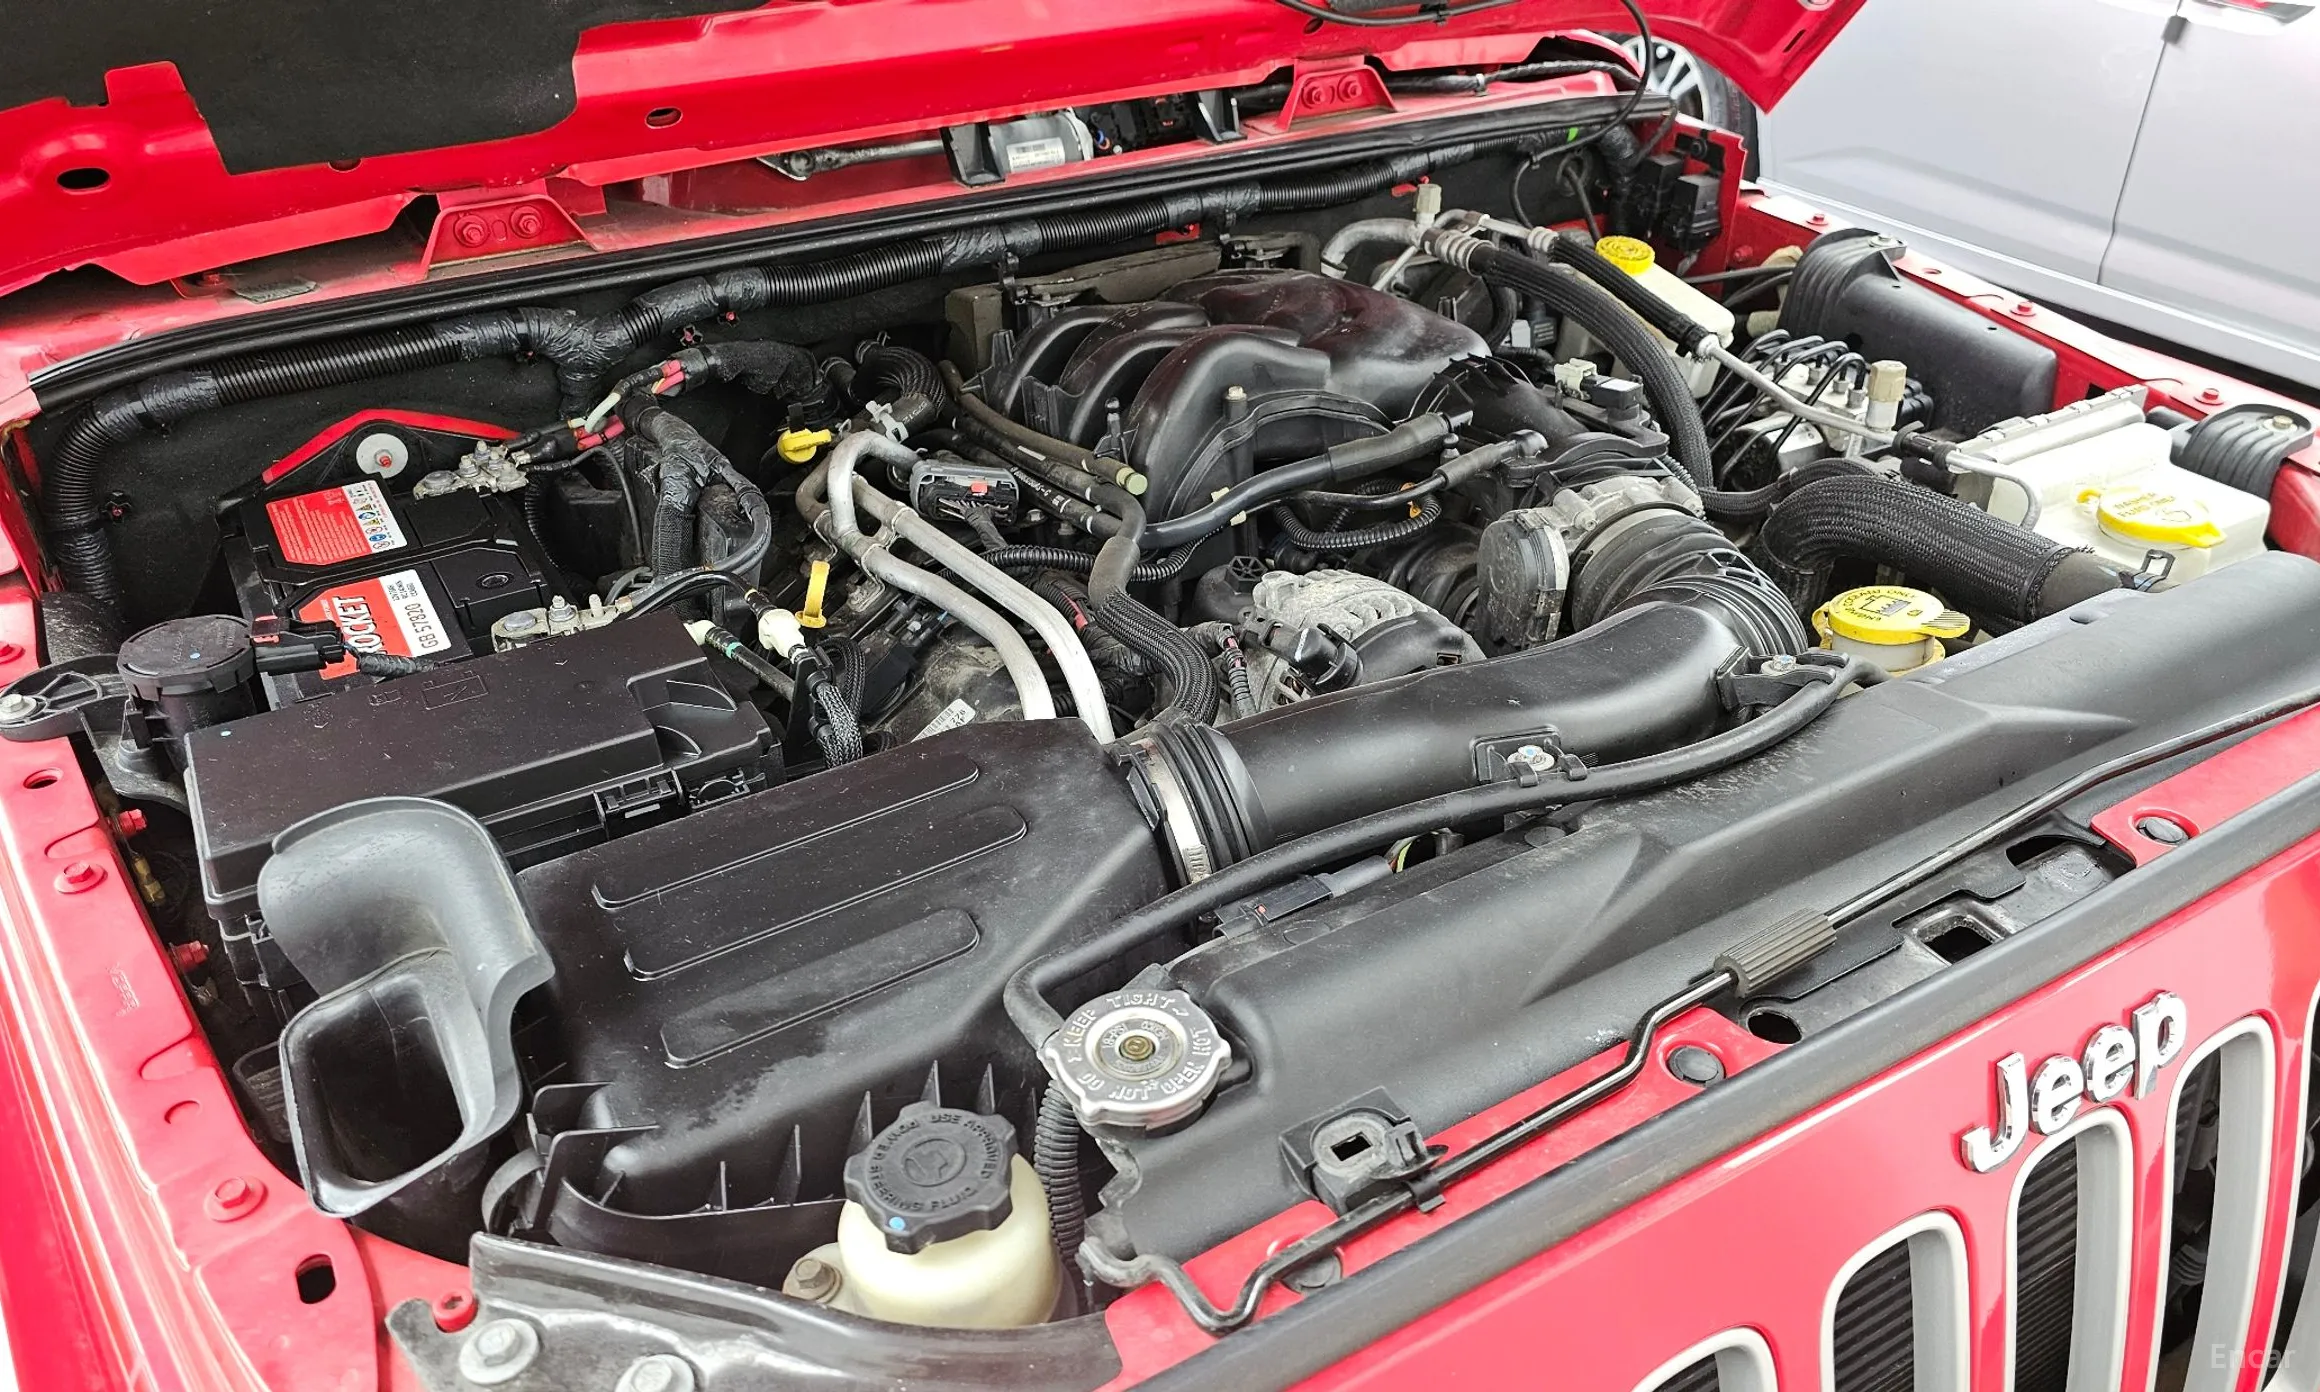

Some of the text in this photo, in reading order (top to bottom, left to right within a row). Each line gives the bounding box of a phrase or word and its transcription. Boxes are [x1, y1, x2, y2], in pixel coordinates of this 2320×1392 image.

[404, 602, 440, 649] GB 57820
[1064, 993, 1176, 1047] KEEP TIGHT
[1077, 1072, 1104, 1090] DO
[1109, 1086, 1150, 1101] NOT
[1160, 1062, 1205, 1095] OPEN
[1190, 1027, 1212, 1056] HOT
[1961, 990, 2187, 1173] Jeep
[930, 1113, 999, 1180] USE APPROVED
[869, 1164, 924, 1212] STEERING
[929, 1185, 980, 1211] FLUID
